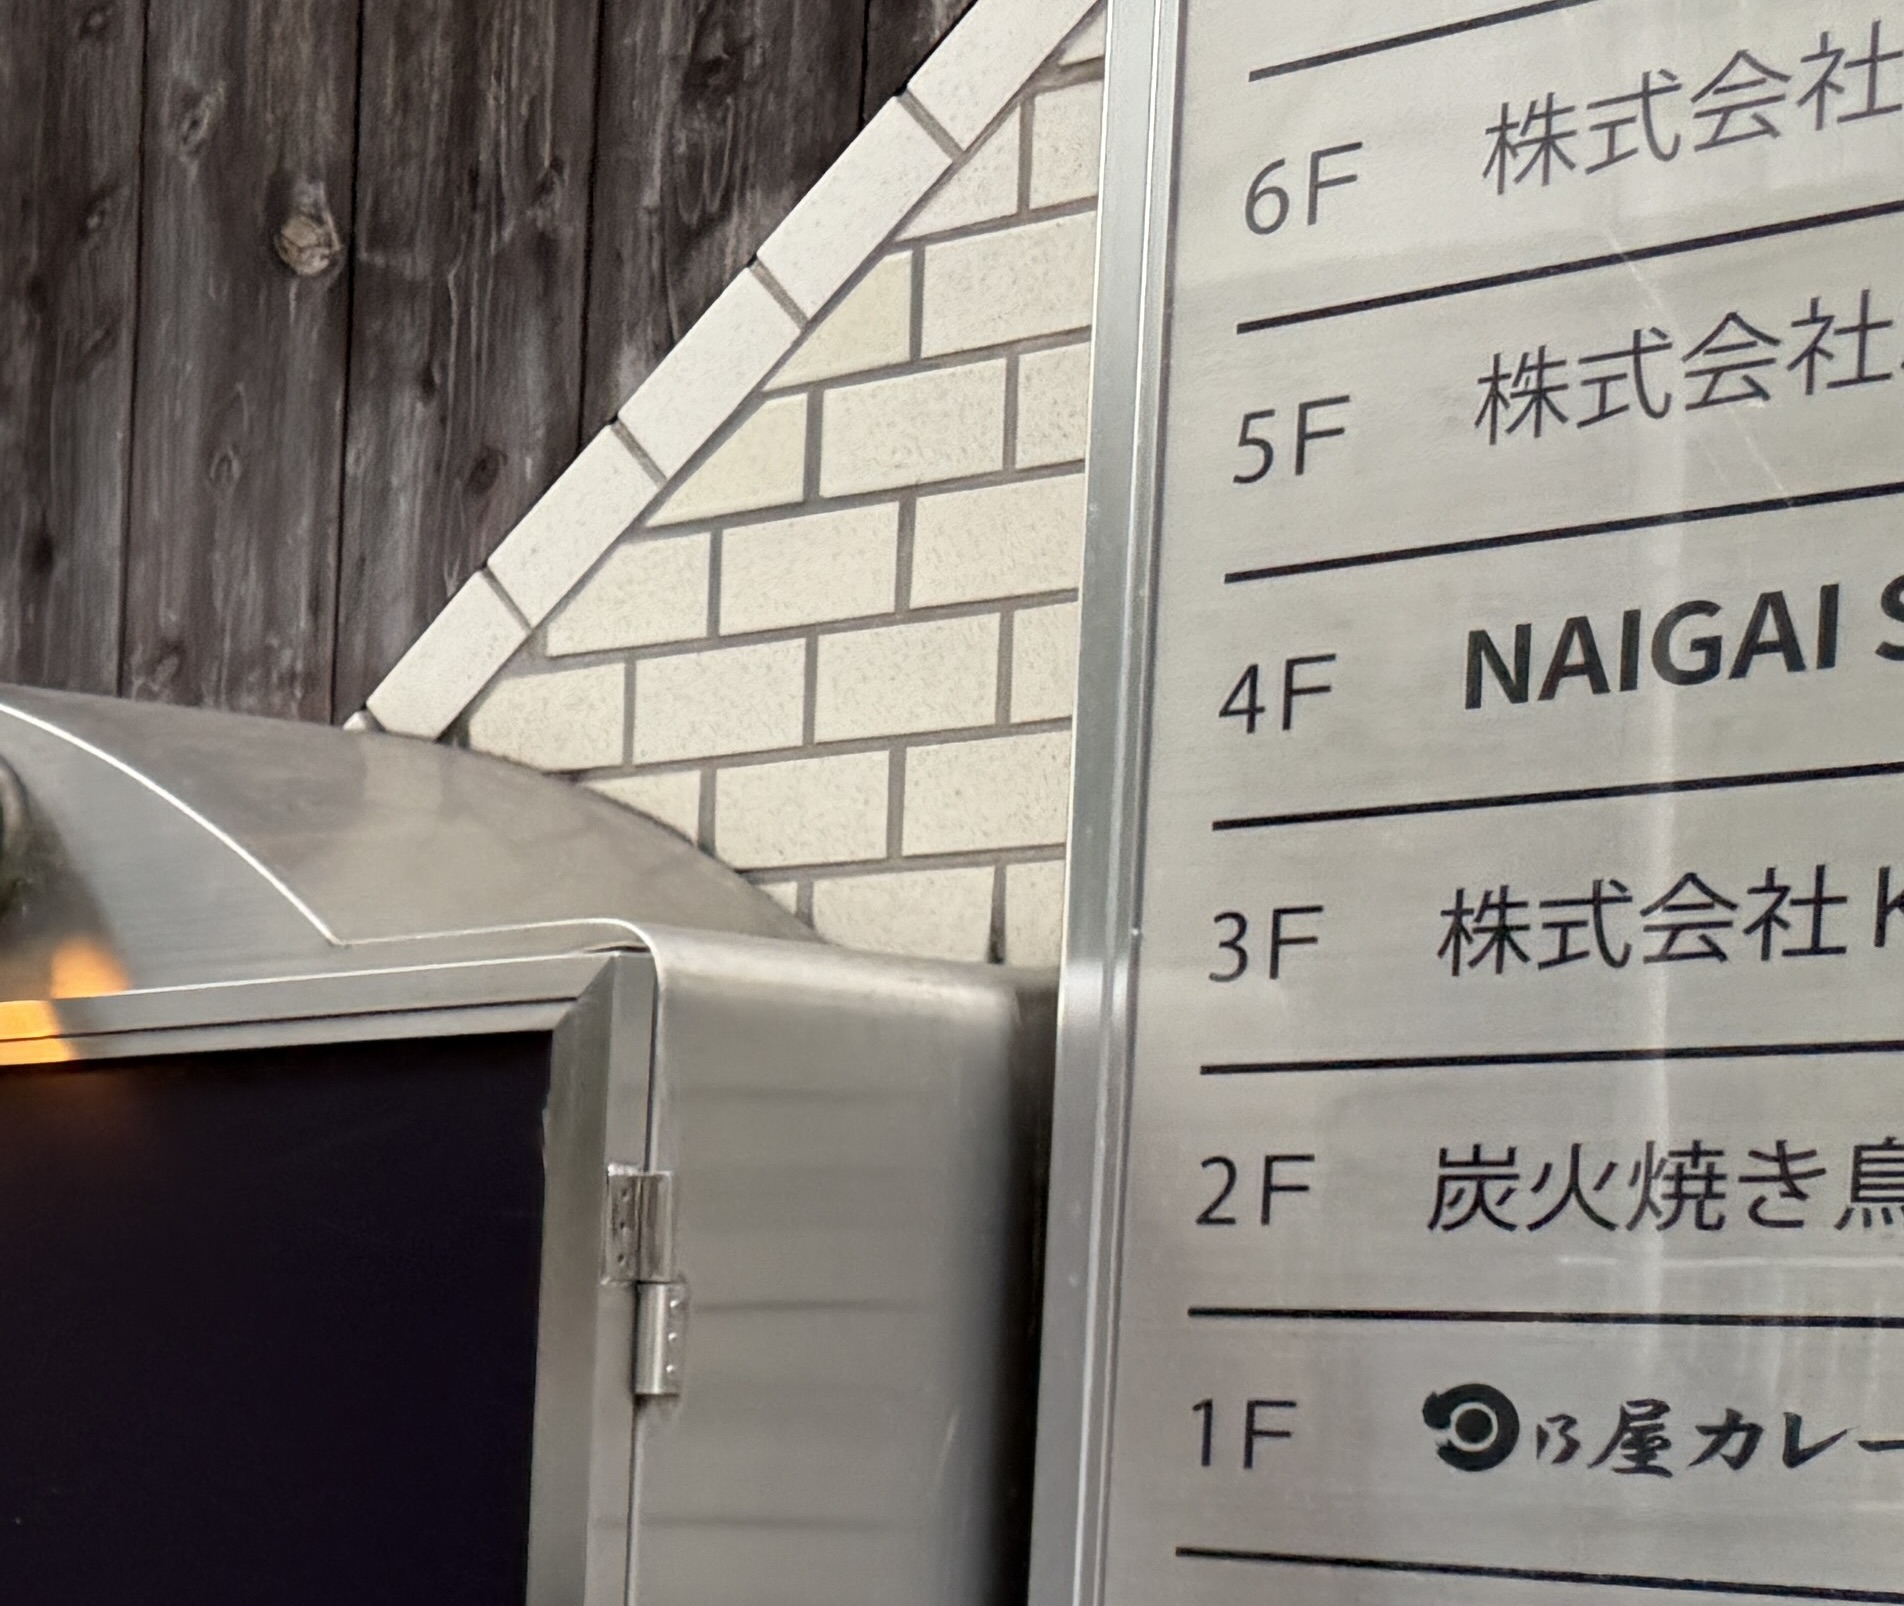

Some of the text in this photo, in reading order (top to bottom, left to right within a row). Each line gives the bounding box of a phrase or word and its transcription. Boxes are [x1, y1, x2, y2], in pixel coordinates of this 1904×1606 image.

[1243, 20, 1904, 236] 6F 株式会社
[1232, 288, 1904, 485] 5F 株式会社
[1217, 652, 1338, 735] 4F
[1463, 583, 1840, 710] NAIGAI
[1207, 904, 1324, 983] 3F
[1194, 1137, 1904, 1232] 2F 炭火焼き鳥
[1191, 1398, 1298, 1471] 1F
